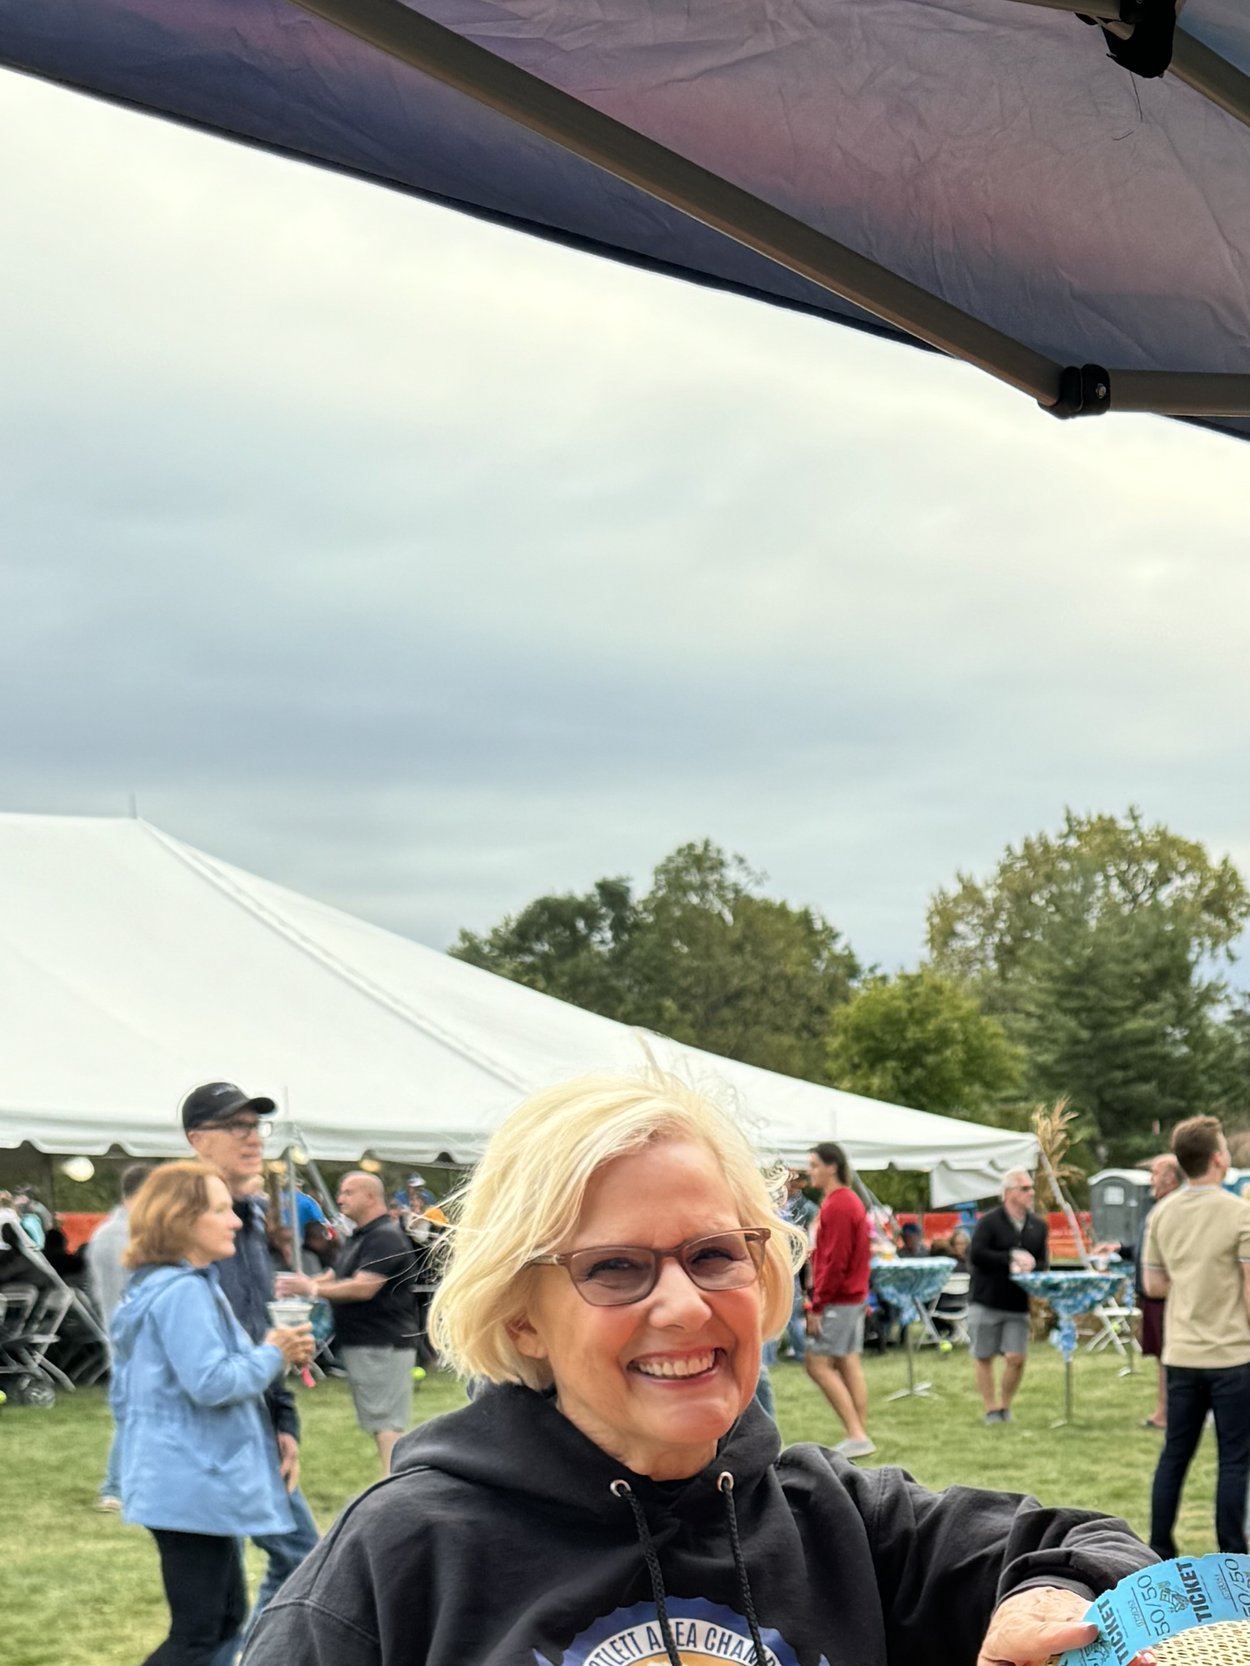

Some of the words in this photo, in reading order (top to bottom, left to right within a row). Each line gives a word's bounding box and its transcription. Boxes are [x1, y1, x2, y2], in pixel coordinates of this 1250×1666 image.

[1137, 1575, 1170, 1637] 50/50
[1176, 1562, 1212, 1622] TICKET
[646, 1621, 697, 1652] AEA
[1098, 1598, 1128, 1665] TICKET
